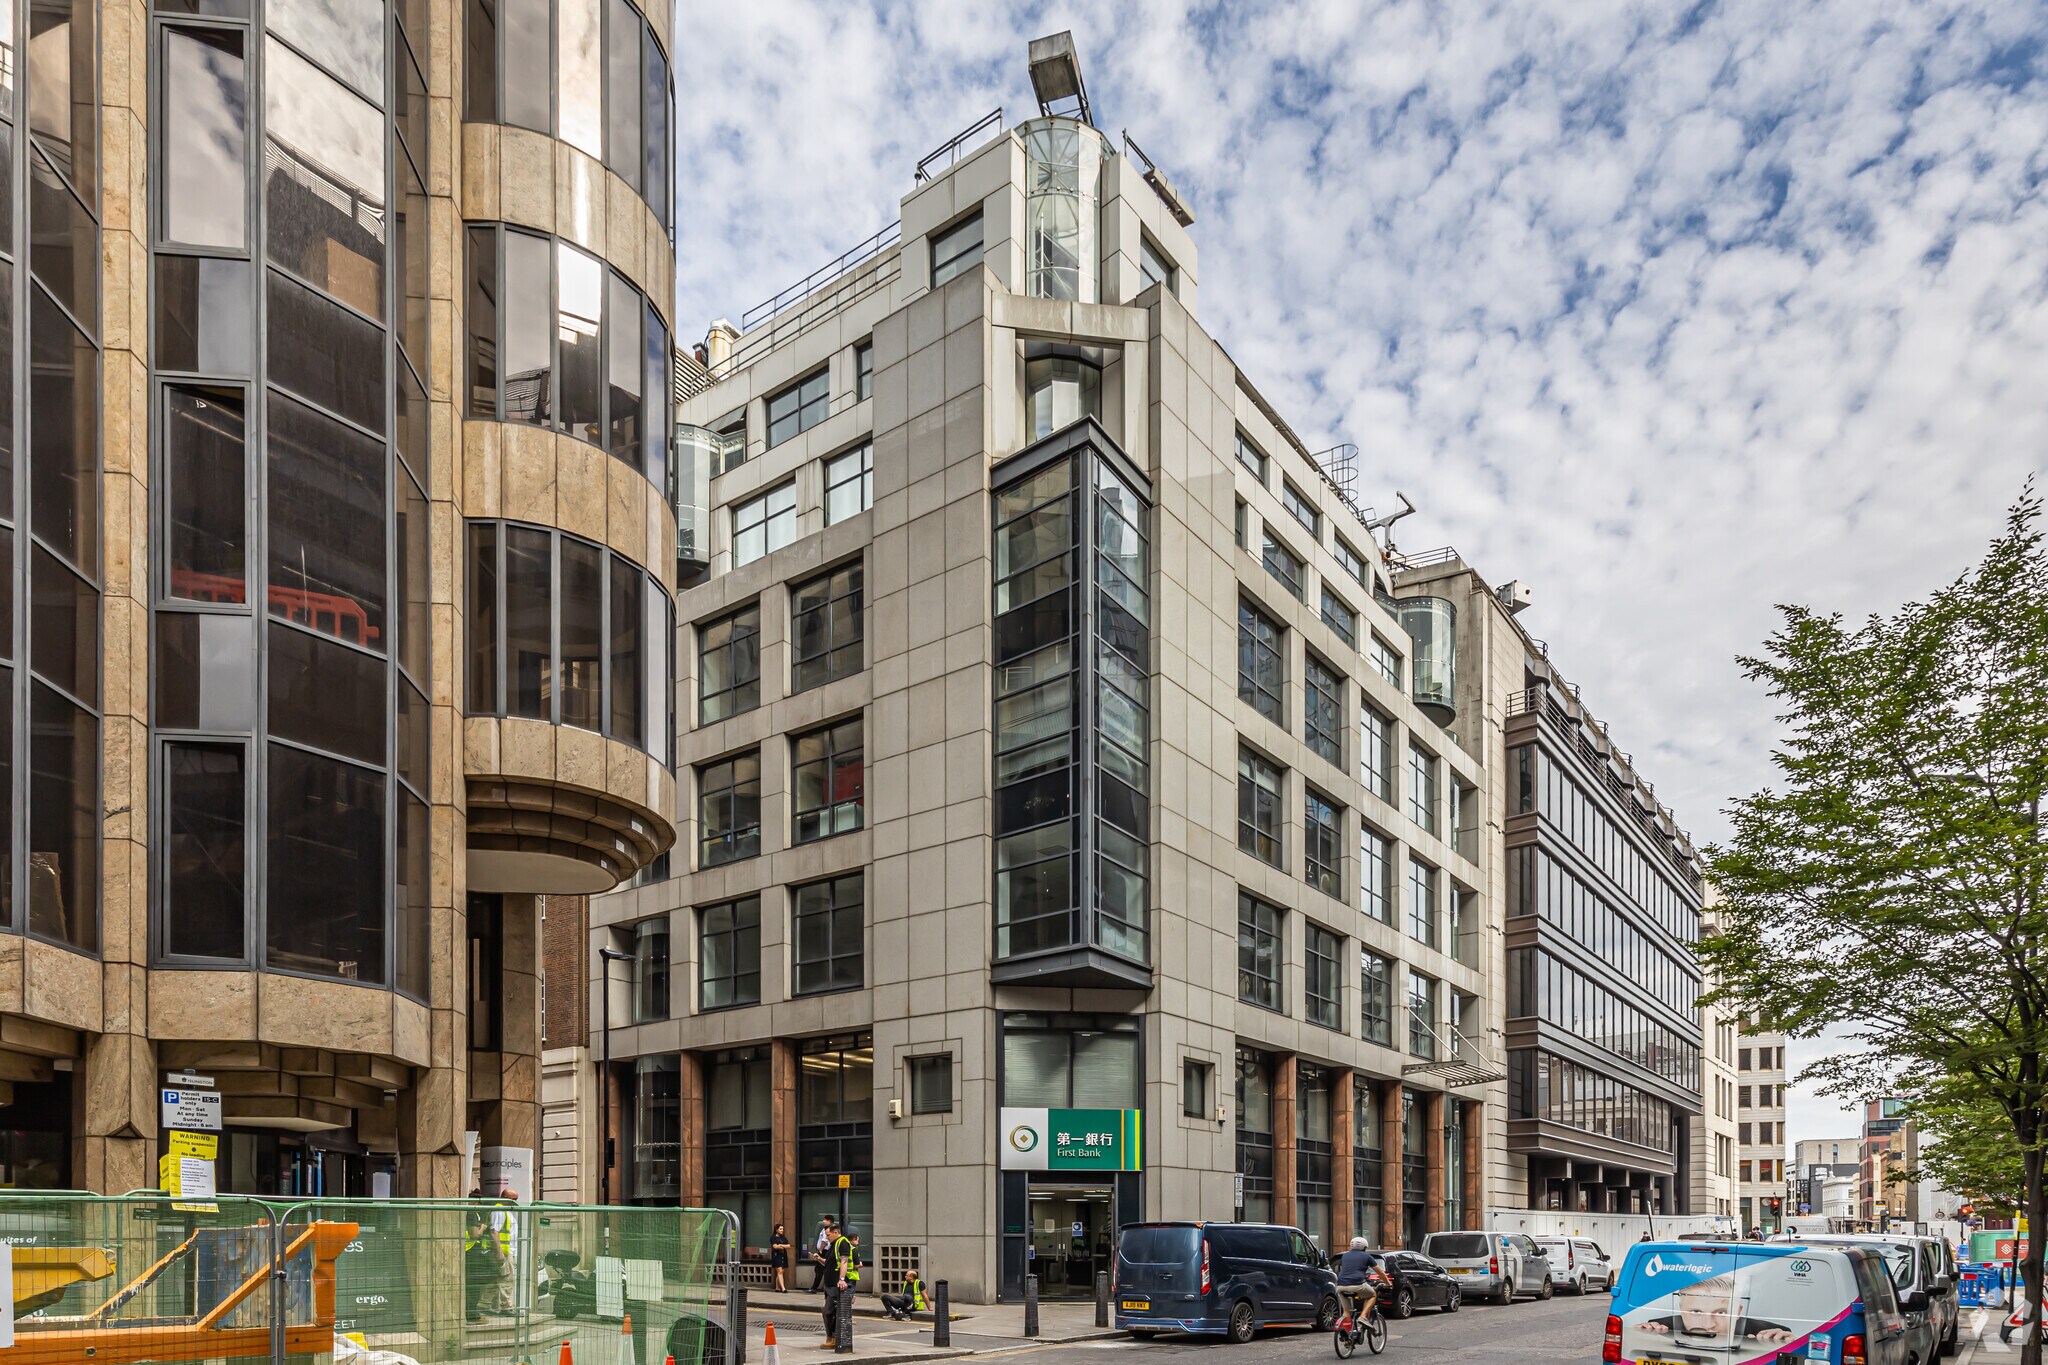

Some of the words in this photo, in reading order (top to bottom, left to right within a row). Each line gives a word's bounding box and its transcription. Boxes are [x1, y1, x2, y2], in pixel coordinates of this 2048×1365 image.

[168, 1093, 177, 1102] P
[179, 1133, 210, 1141] WARNING
[1057, 1132, 1113, 1146] 第一銀行
[1057, 1148, 1076, 1157] First
[1078, 1148, 1101, 1157] Bank
[26, 1236, 38, 1245] of
[1662, 1264, 1713, 1274] waterlogic
